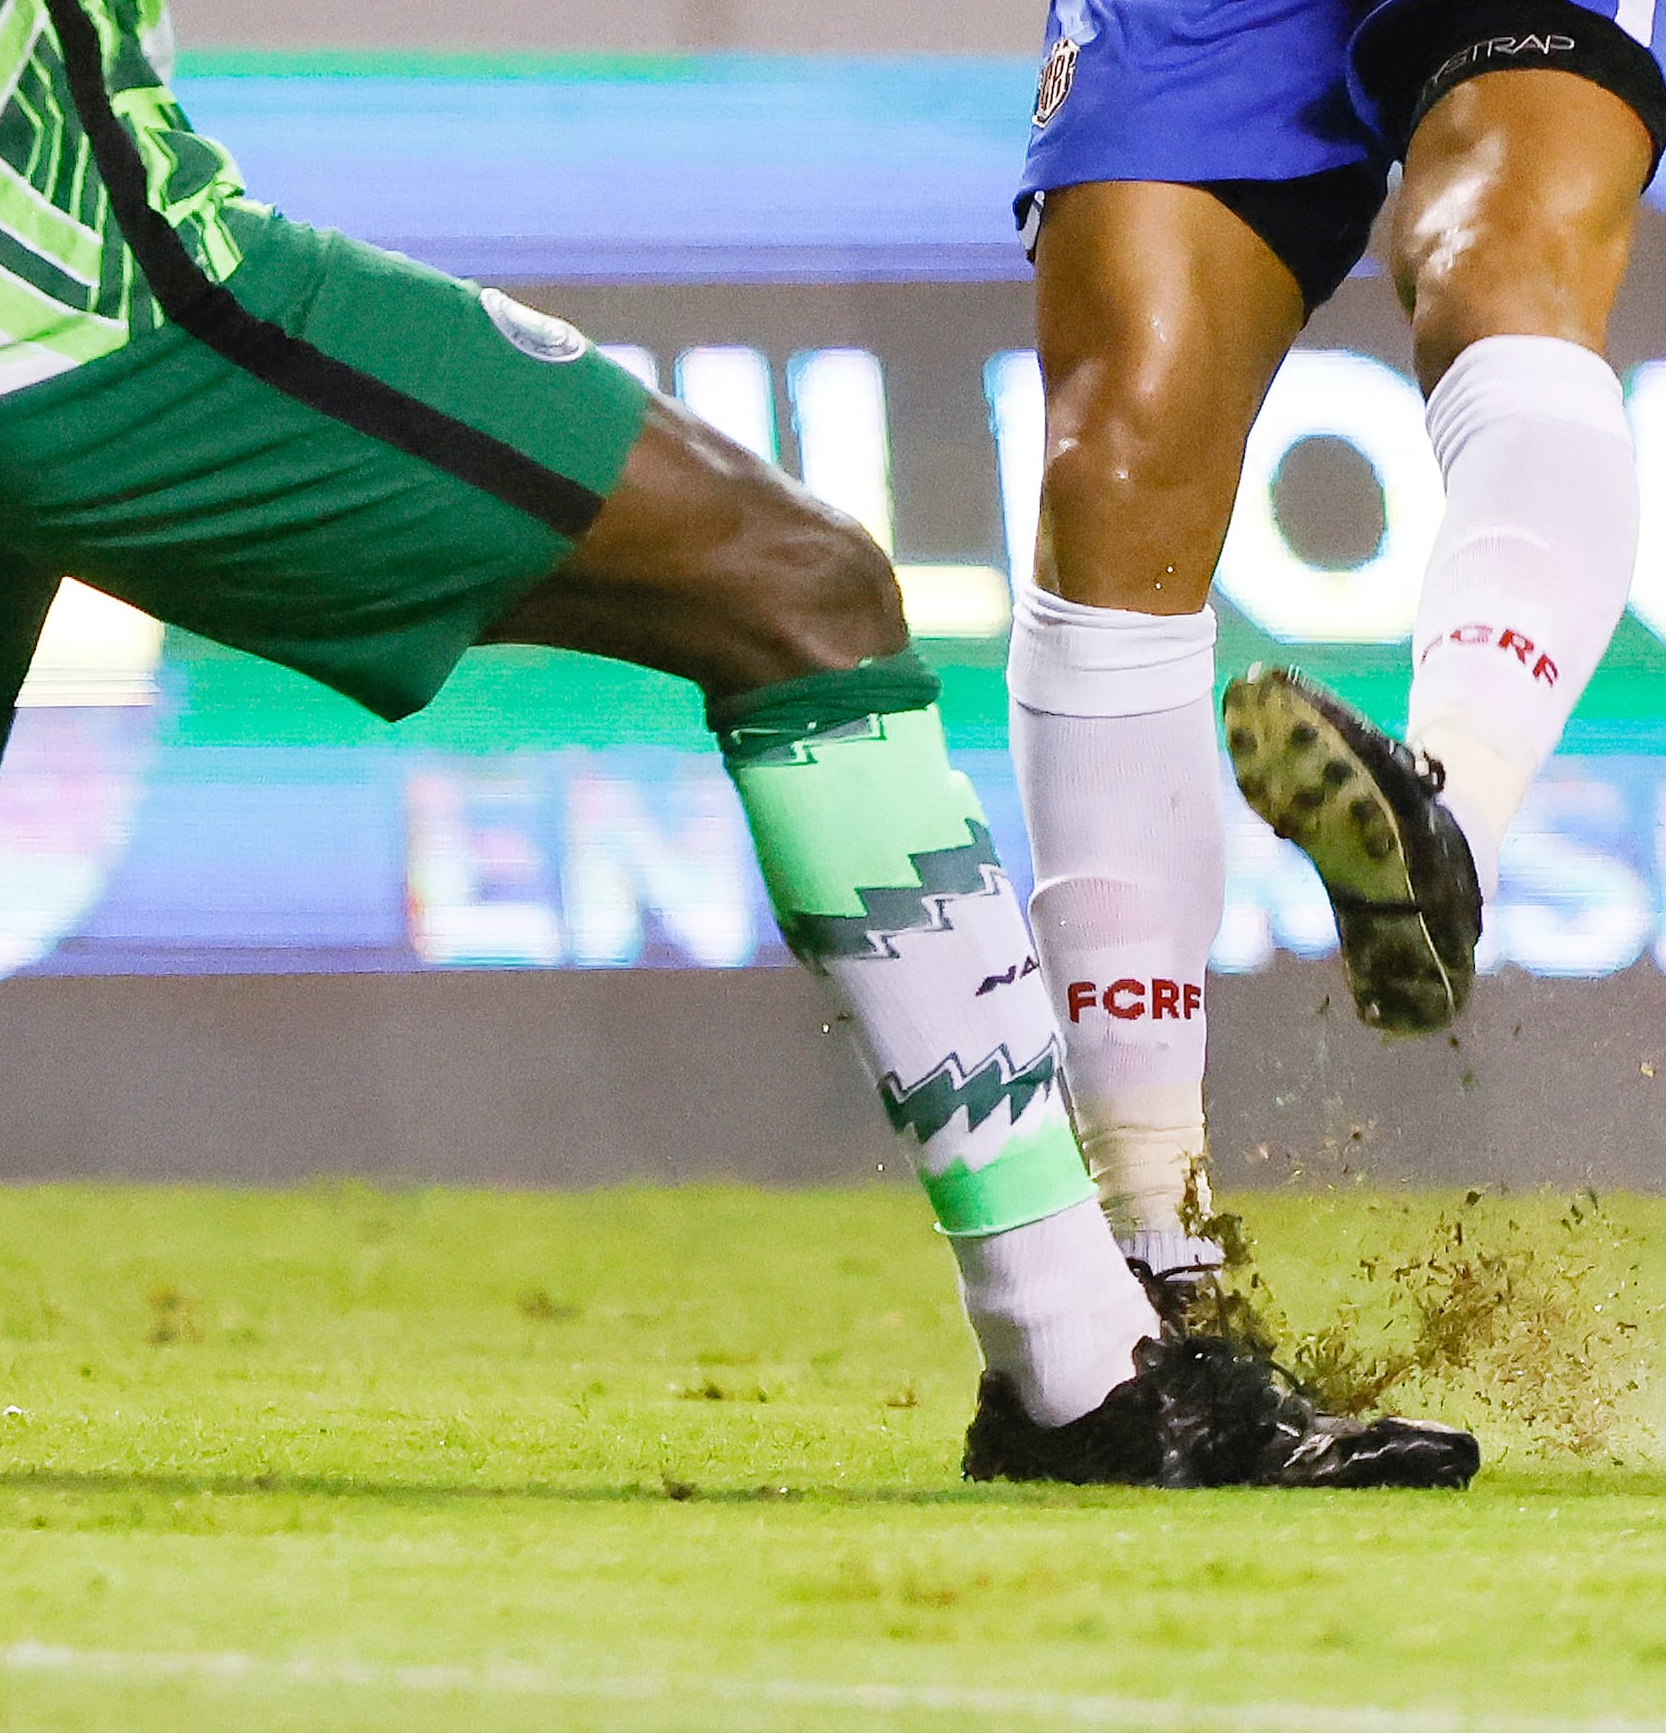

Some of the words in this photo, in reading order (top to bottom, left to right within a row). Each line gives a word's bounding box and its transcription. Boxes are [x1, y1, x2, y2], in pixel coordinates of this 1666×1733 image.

[1420, 624, 1560, 688] CRF
[407, 767, 753, 969] EN
[1066, 977, 1202, 1024] FCRF
